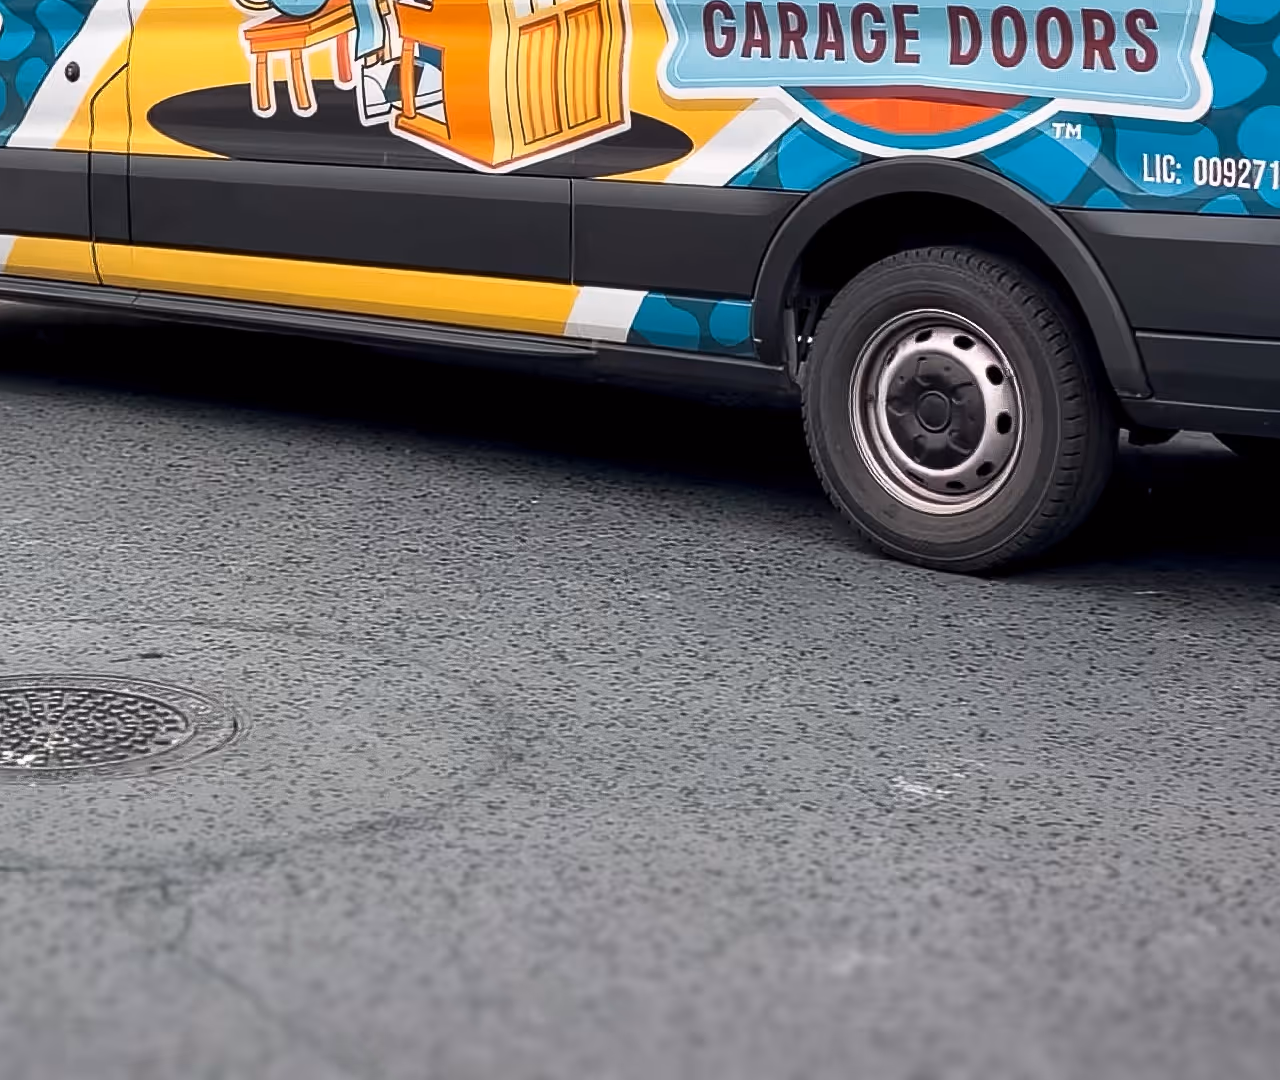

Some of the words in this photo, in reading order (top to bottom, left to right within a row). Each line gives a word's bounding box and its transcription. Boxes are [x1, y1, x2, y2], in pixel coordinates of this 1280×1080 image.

[947, 4, 1161, 73] DOORS
[1052, 122, 1082, 140] TM
[1142, 153, 1182, 185] LIC:
